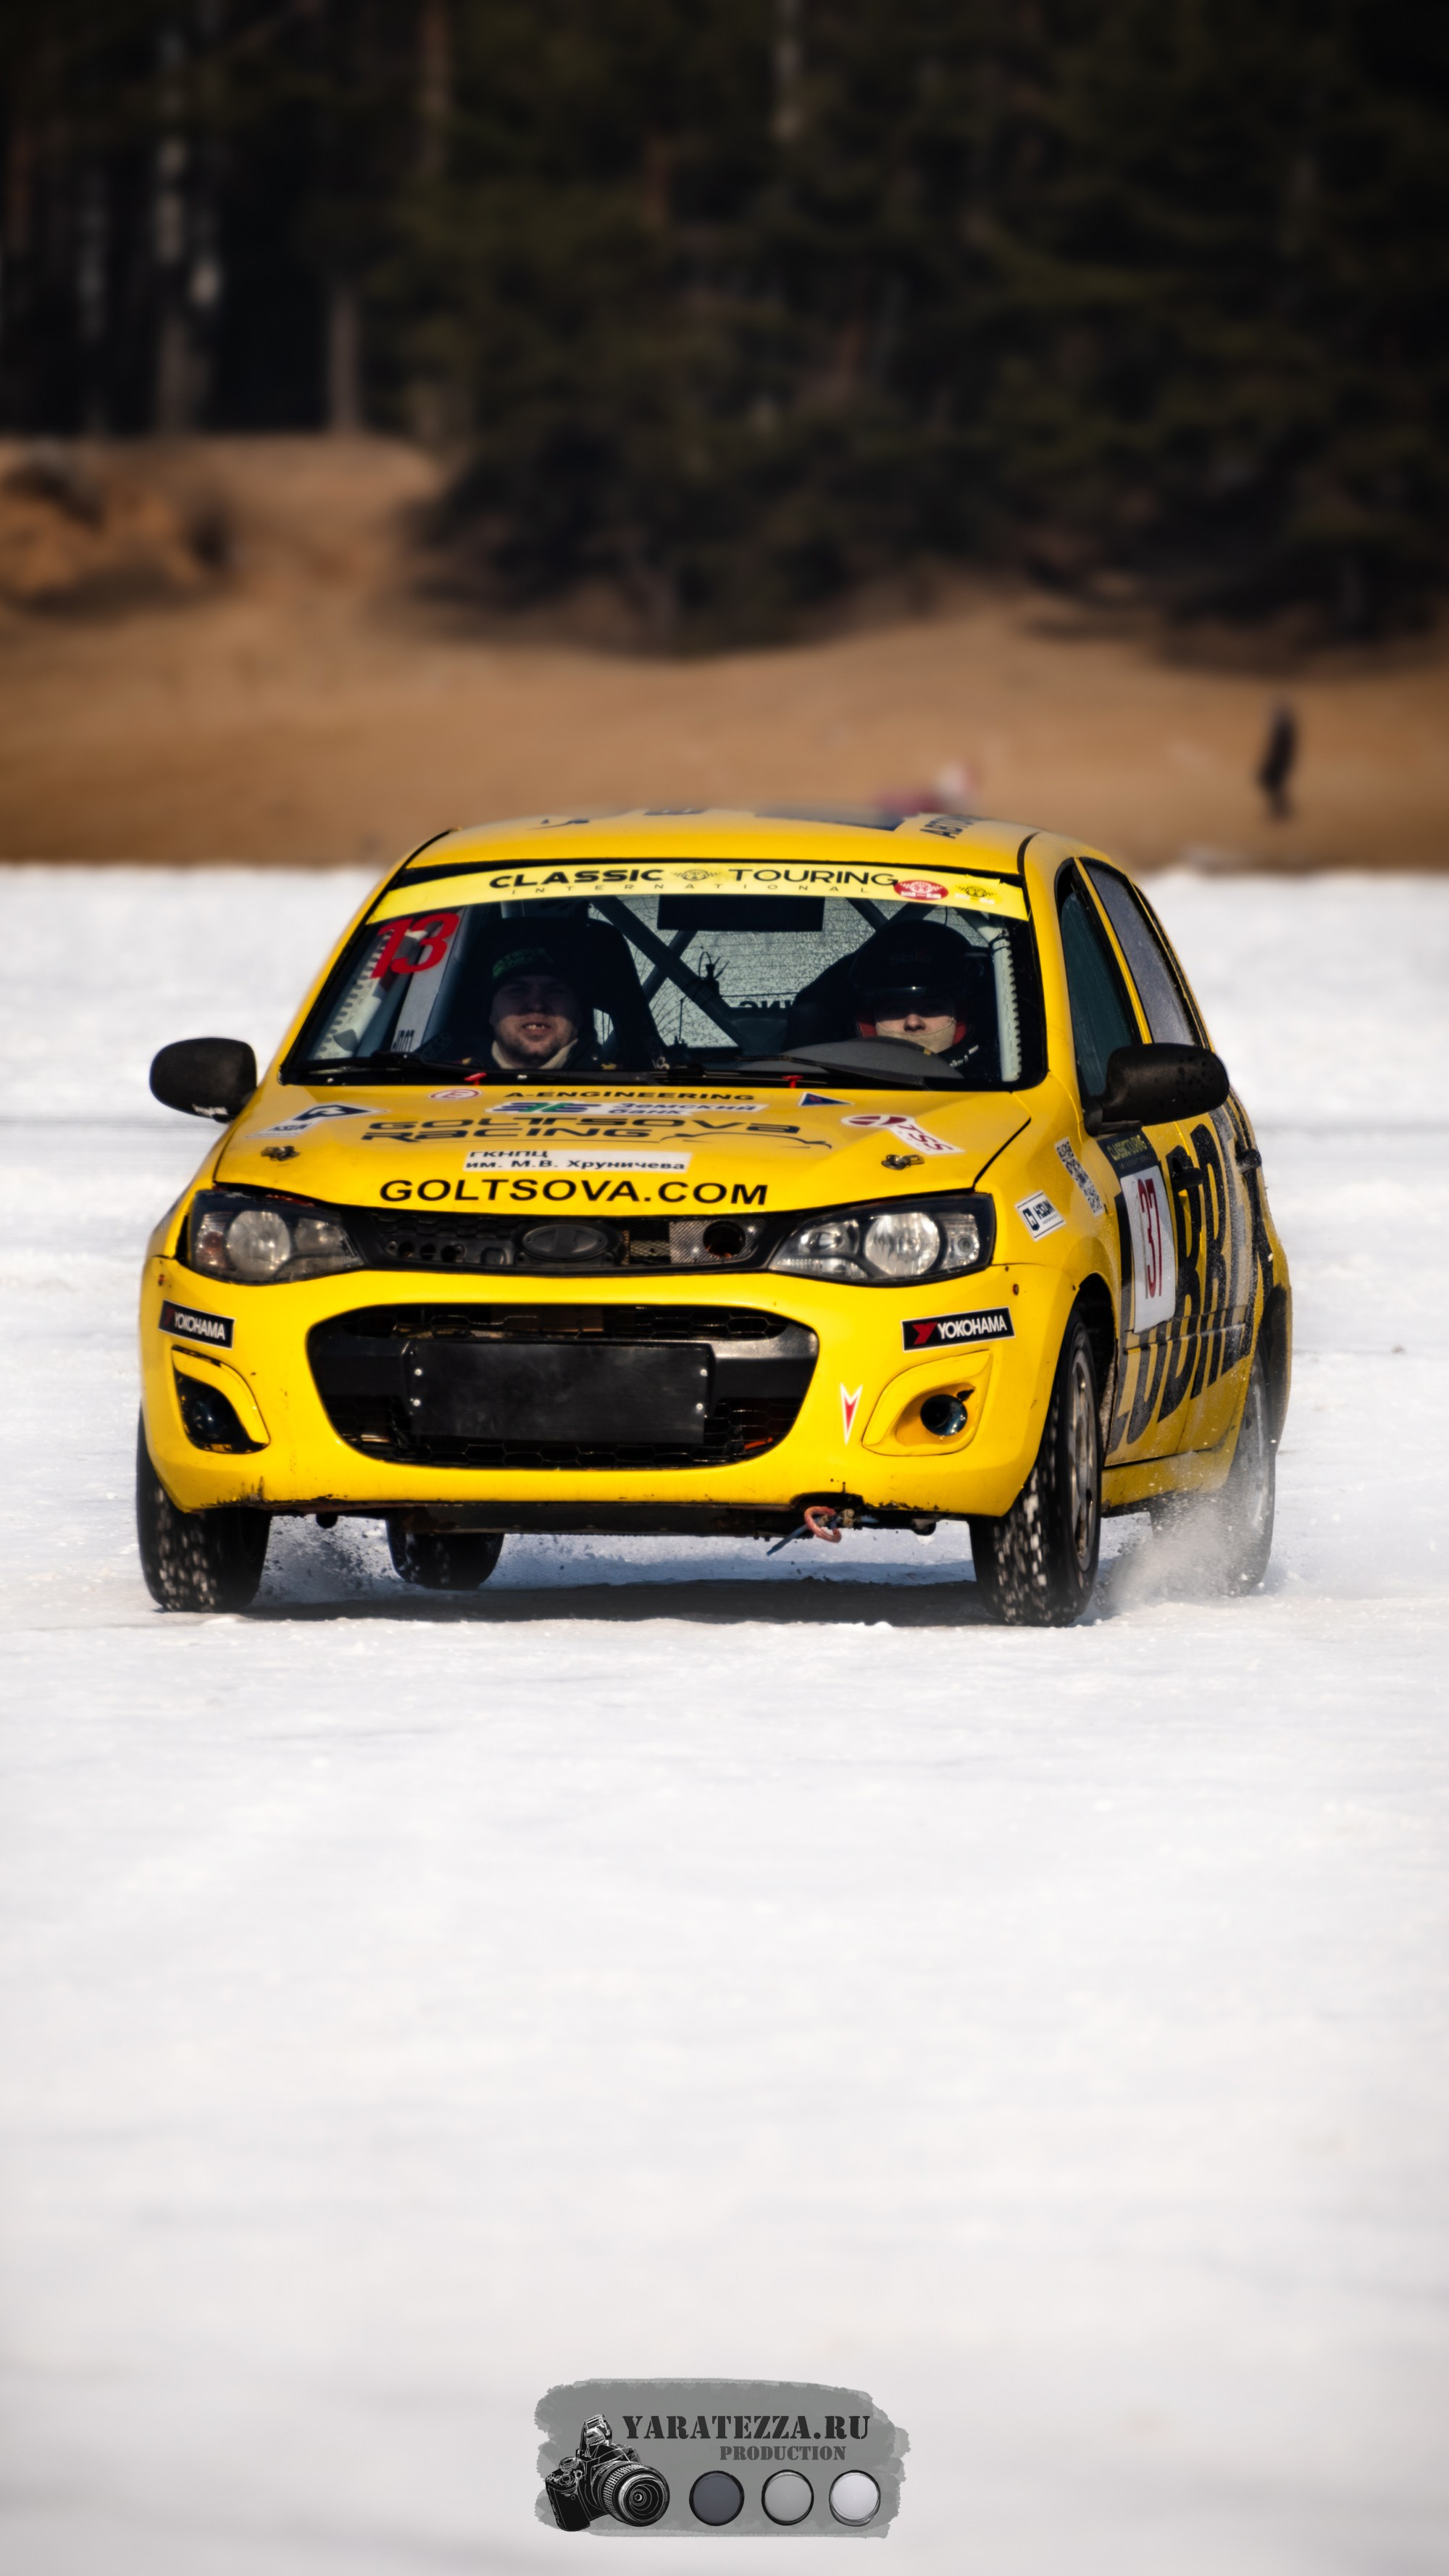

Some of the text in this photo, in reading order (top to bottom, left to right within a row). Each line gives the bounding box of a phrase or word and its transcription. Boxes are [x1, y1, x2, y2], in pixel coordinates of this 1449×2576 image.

[488, 869, 898, 889] CLASSIC TOURING
[511, 884, 869, 895] INTERNATIONAL
[368, 912, 460, 979] 13
[504, 1091, 755, 1100] A-ENGINEERING
[613, 1103, 757, 1111] Земский
[566, 1160, 685, 1170] Хруничева
[379, 1179, 769, 1206] GOLTSOVA.COM
[175, 1312, 226, 1340] YOKOHAMA
[938, 1315, 1008, 1339] YOKOHAMA
